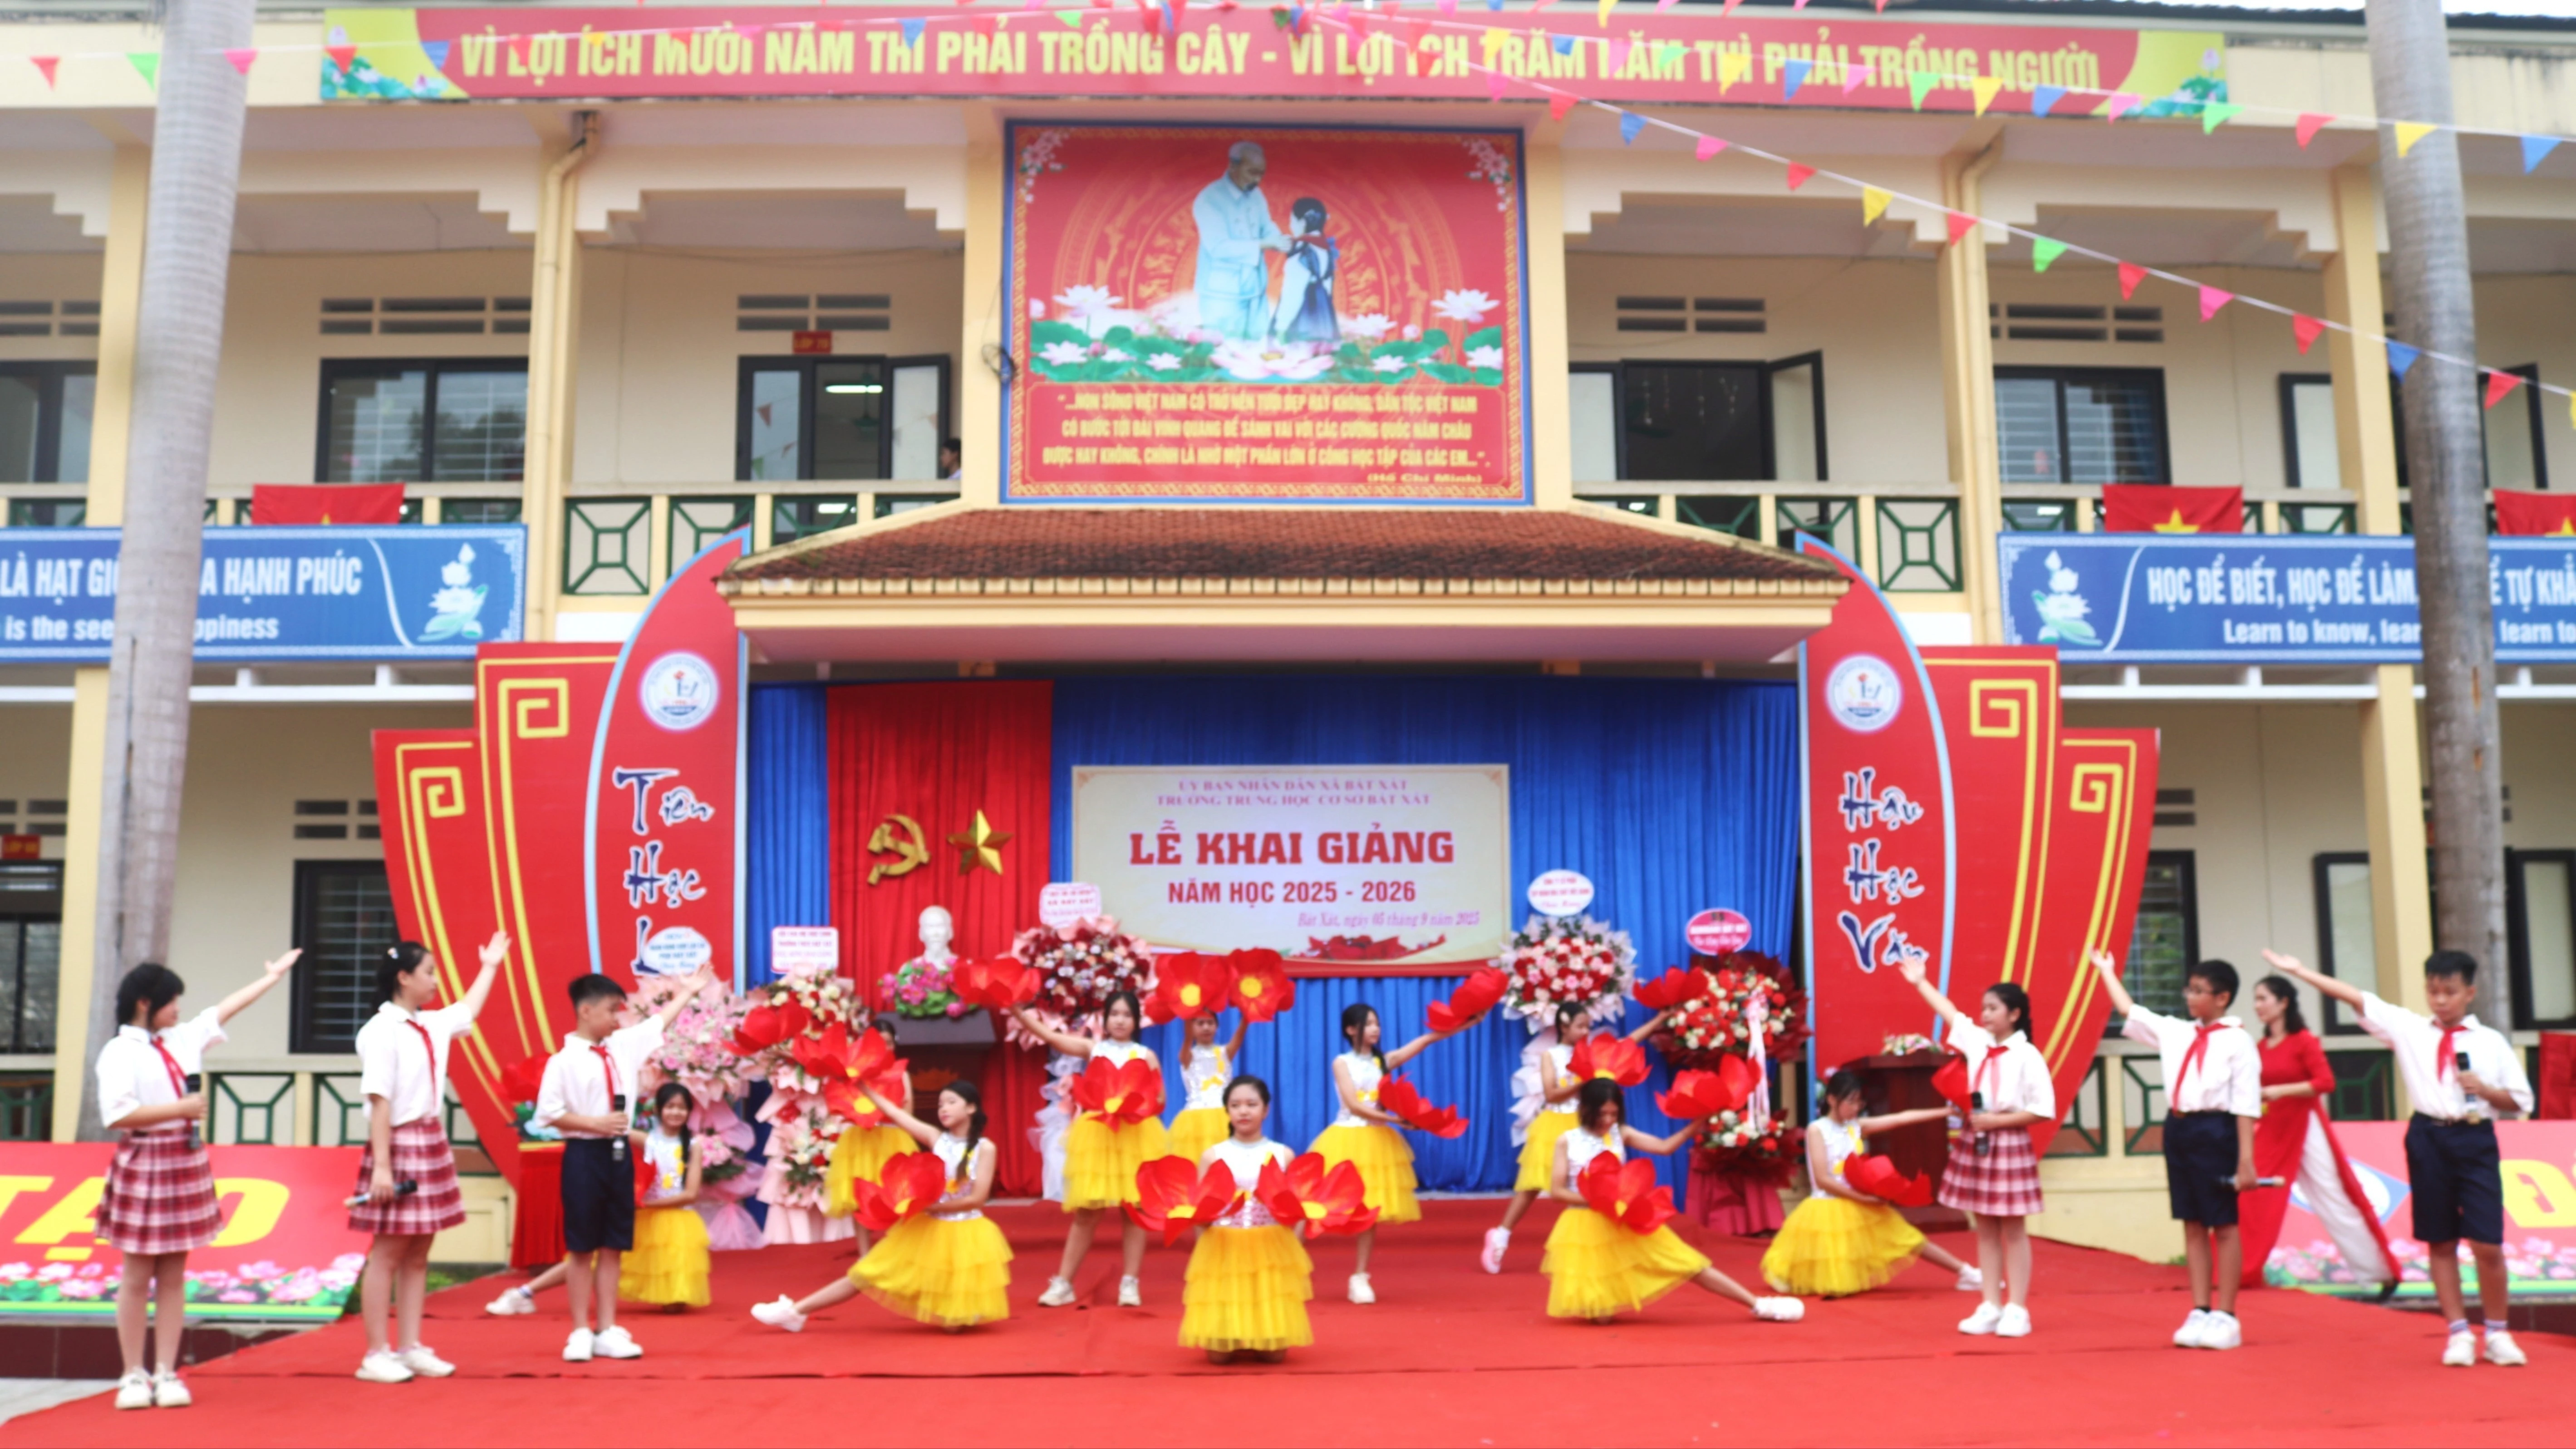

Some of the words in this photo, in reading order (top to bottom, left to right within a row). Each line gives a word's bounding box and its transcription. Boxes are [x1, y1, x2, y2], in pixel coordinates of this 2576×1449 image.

[461, 25, 497, 76] VÌ
[764, 21, 854, 74] NĂM
[1176, 24, 1251, 75] CÂY
[1287, 24, 1324, 75] VÌ
[1336, 30, 1394, 85] LỢI
[1160, 393, 1187, 410] NAM
[1450, 395, 1477, 413] NAM
[1, 552, 29, 597] LÀ
[35, 559, 83, 605] HẠT
[223, 557, 291, 604] HẠNH
[295, 550, 363, 595] PHÚC
[2147, 566, 2192, 612] HỌC
[2197, 553, 2226, 604] ĐỂ
[2230, 555, 2285, 610] BIẾT,
[2287, 566, 2332, 612] HỌC
[2336, 553, 2365, 604] ĐỂ
[2504, 565, 2534, 614] TỰ
[32, 614, 68, 640] the
[74, 618, 115, 640] see
[2224, 619, 2283, 644] Learn
[2287, 620, 2310, 643] to
[2314, 619, 2376, 646] know,
[2380, 618, 2422, 643] lear
[2500, 619, 2553, 643] learn
[2557, 619, 2576, 643] to
[1840, 767, 1923, 831] Hậu
[1129, 820, 1182, 865] LỄ
[1196, 832, 1303, 865] KHAI
[1317, 822, 1455, 864] GIẢNG
[624, 840, 707, 909] Học
[1168, 877, 1221, 903] NĂM
[1229, 881, 1274, 908] HỌC
[1283, 881, 1337, 903] 2025
[1361, 880, 1416, 902] 2026
[1845, 839, 1925, 904] Học
